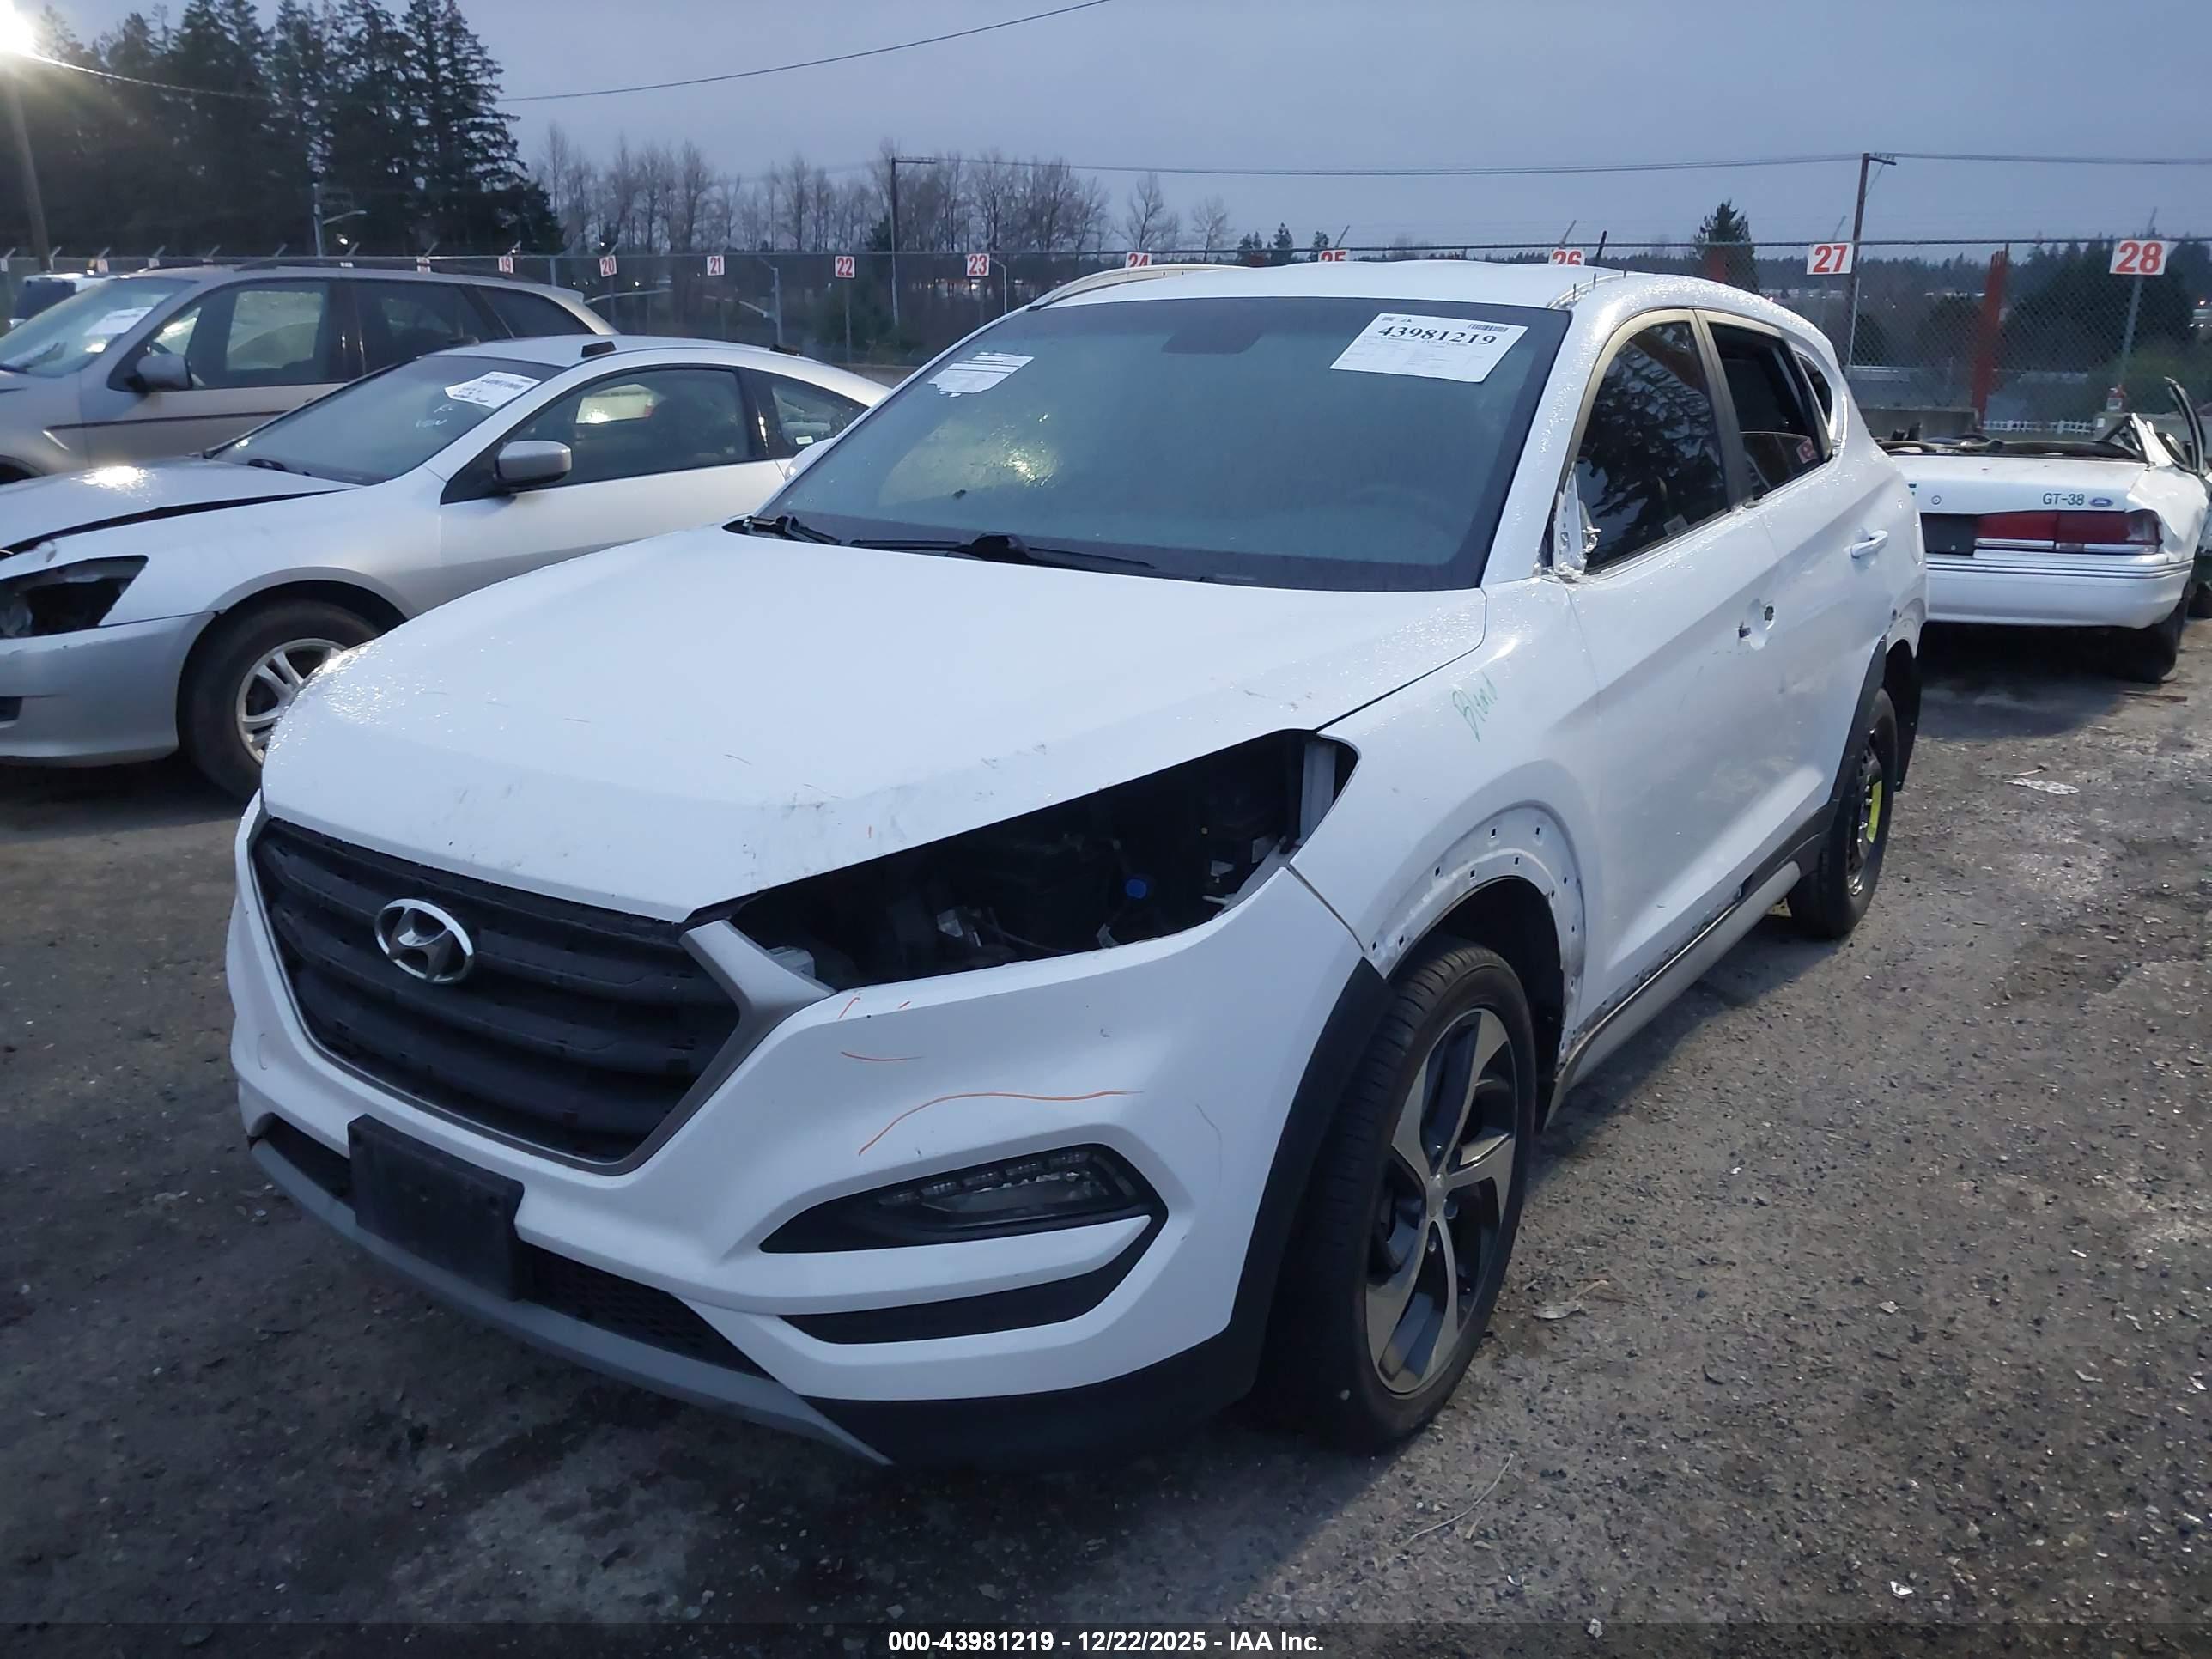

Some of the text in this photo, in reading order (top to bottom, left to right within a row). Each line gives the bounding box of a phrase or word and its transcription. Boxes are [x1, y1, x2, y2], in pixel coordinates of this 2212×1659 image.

[601, 257, 615, 275] 20
[709, 256, 722, 275] 21
[836, 257, 854, 276] 22
[969, 254, 988, 276] 23
[1813, 245, 1847, 273] 27
[2115, 241, 2163, 274] 28
[1377, 325, 1498, 345] 43981219
[2042, 492, 2085, 507] GT-38
